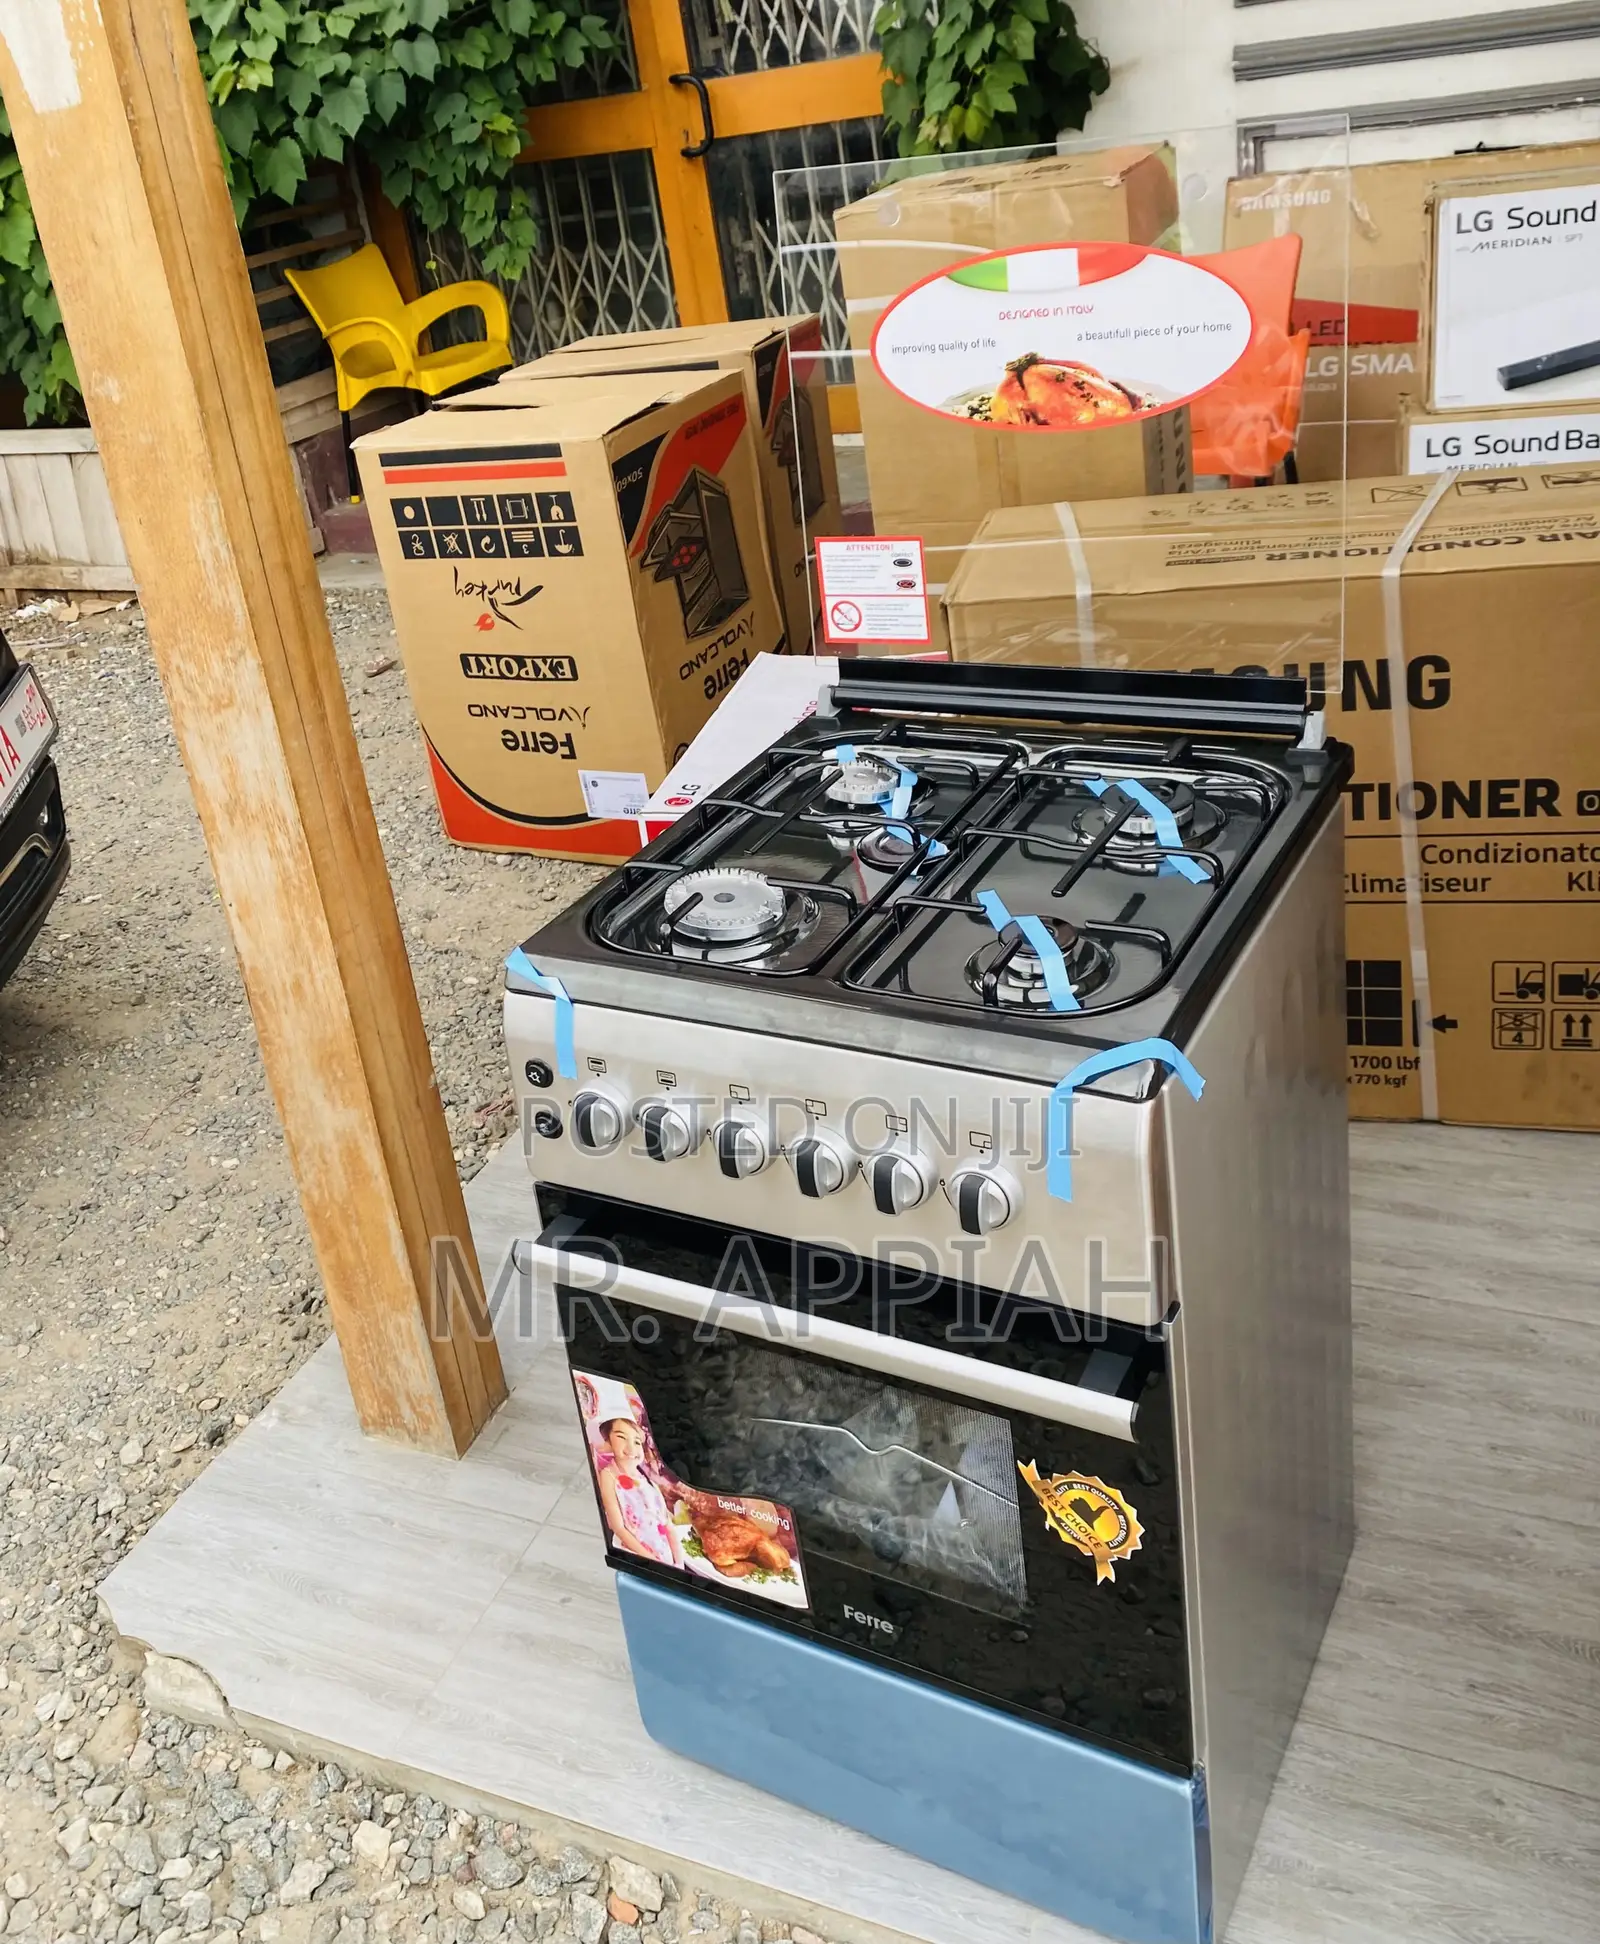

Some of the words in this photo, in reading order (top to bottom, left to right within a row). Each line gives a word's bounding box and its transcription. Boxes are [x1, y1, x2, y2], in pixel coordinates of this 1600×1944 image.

[1456, 210, 1493, 235] LG
[1507, 200, 1597, 230] Sound
[998, 307, 1050, 320] DESIGNED
[1053, 306, 1064, 317] IN
[1066, 304, 1095, 316] ITALY
[1076, 332, 1083, 342] a
[1085, 327, 1132, 342] beautifull
[1133, 325, 1161, 339] piece
[1163, 324, 1175, 336] of
[1176, 323, 1201, 337] your
[1203, 320, 1232, 333] home
[891, 341, 936, 356] improving
[938, 339, 969, 354] quality
[971, 338, 980, 350] of
[982, 337, 997, 349] life
[1305, 355, 1339, 377] LG
[1426, 437, 1461, 458] LG
[1537, 529, 1600, 543] AIR
[679, 621, 747, 681] VOLCANO
[466, 655, 574, 680] EXPORT
[467, 703, 573, 722] VOLCANO
[501, 728, 577, 760] Ferre
[676, 783, 701, 796] LG
[1344, 872, 1492, 894] limaiseur
[1350, 1055, 1392, 1070] 1700
[1384, 1073, 1407, 1089] kgf
[1072, 1483, 1090, 1491] BEST
[1090, 1487, 1120, 1511] QUALITY
[717, 1496, 747, 1515] better
[750, 1508, 790, 1531] cooking
[1042, 1488, 1065, 1511] BEST
[1065, 1511, 1103, 1549] CHOICE
[842, 1604, 895, 1634] Ferre
